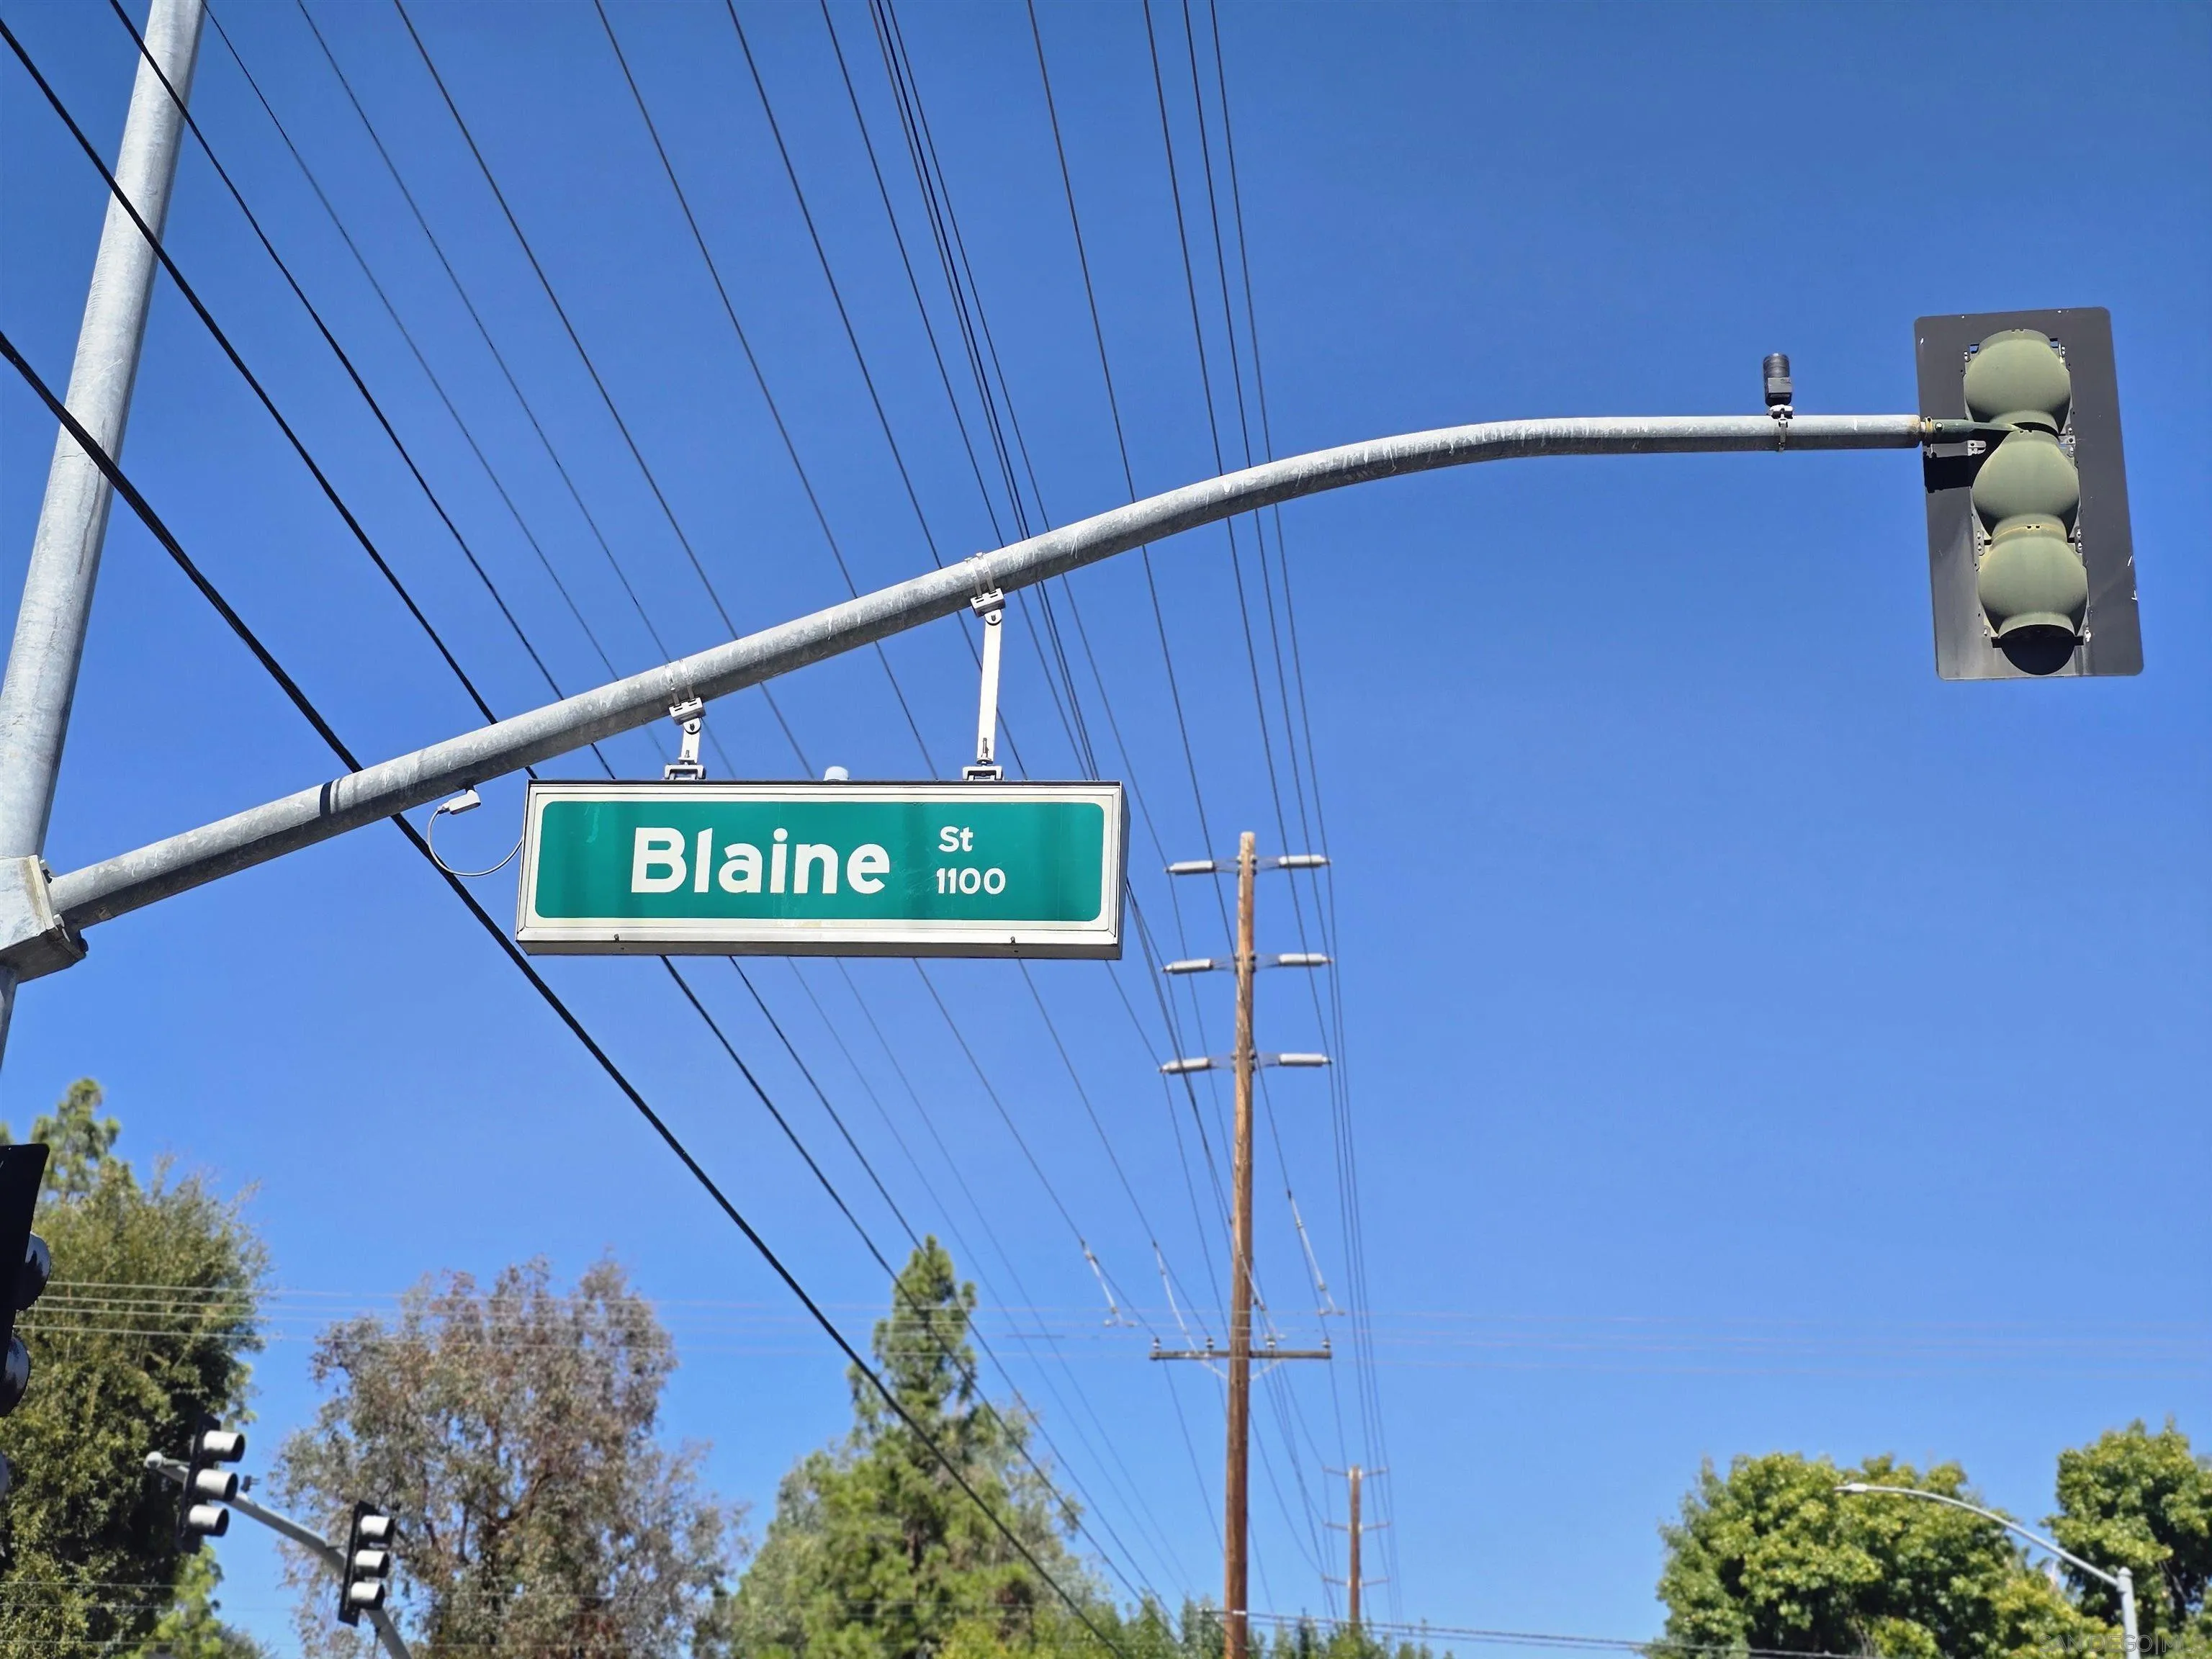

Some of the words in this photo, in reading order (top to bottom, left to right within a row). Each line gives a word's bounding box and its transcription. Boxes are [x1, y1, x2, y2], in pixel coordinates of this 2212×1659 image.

[631, 827, 890, 894] Blaine
[938, 826, 974, 853] St
[936, 868, 1006, 894] 1100
